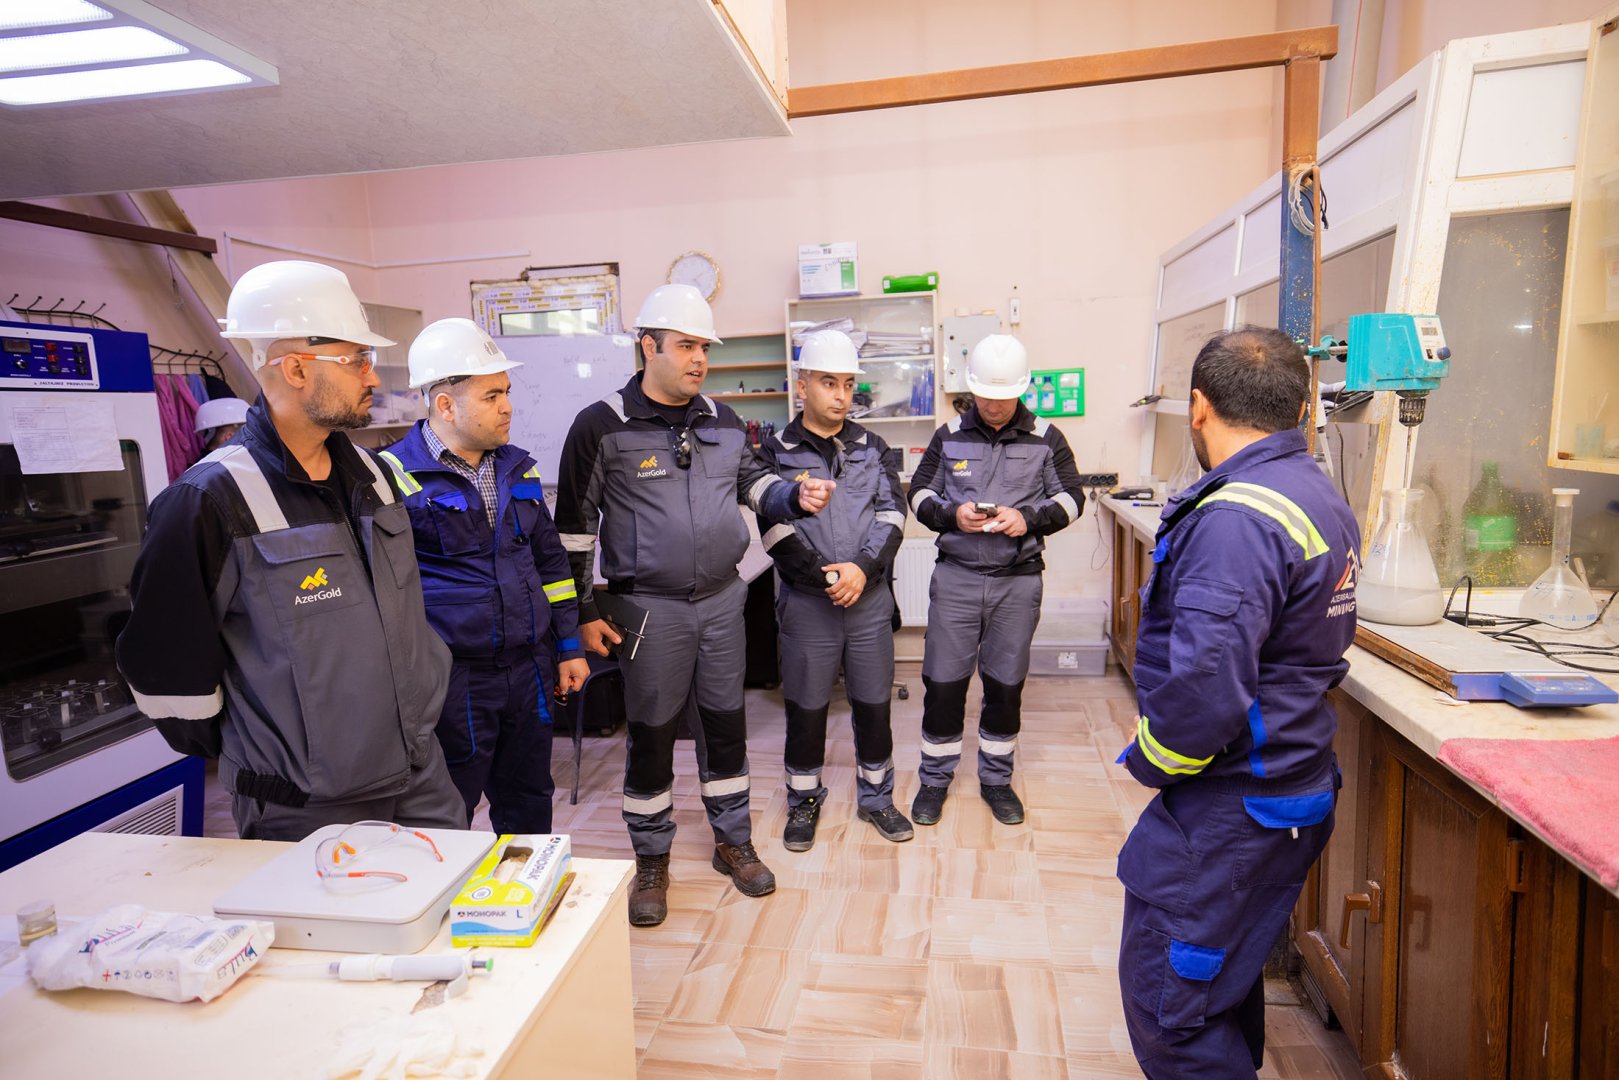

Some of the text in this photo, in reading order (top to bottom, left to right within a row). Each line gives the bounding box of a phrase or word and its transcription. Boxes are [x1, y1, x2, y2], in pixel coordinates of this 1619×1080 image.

[637, 469, 667, 478] AzerGold
[294, 587, 342, 606] AzerGold
[1326, 601, 1356, 618] MINING
[516, 909, 524, 918] L
